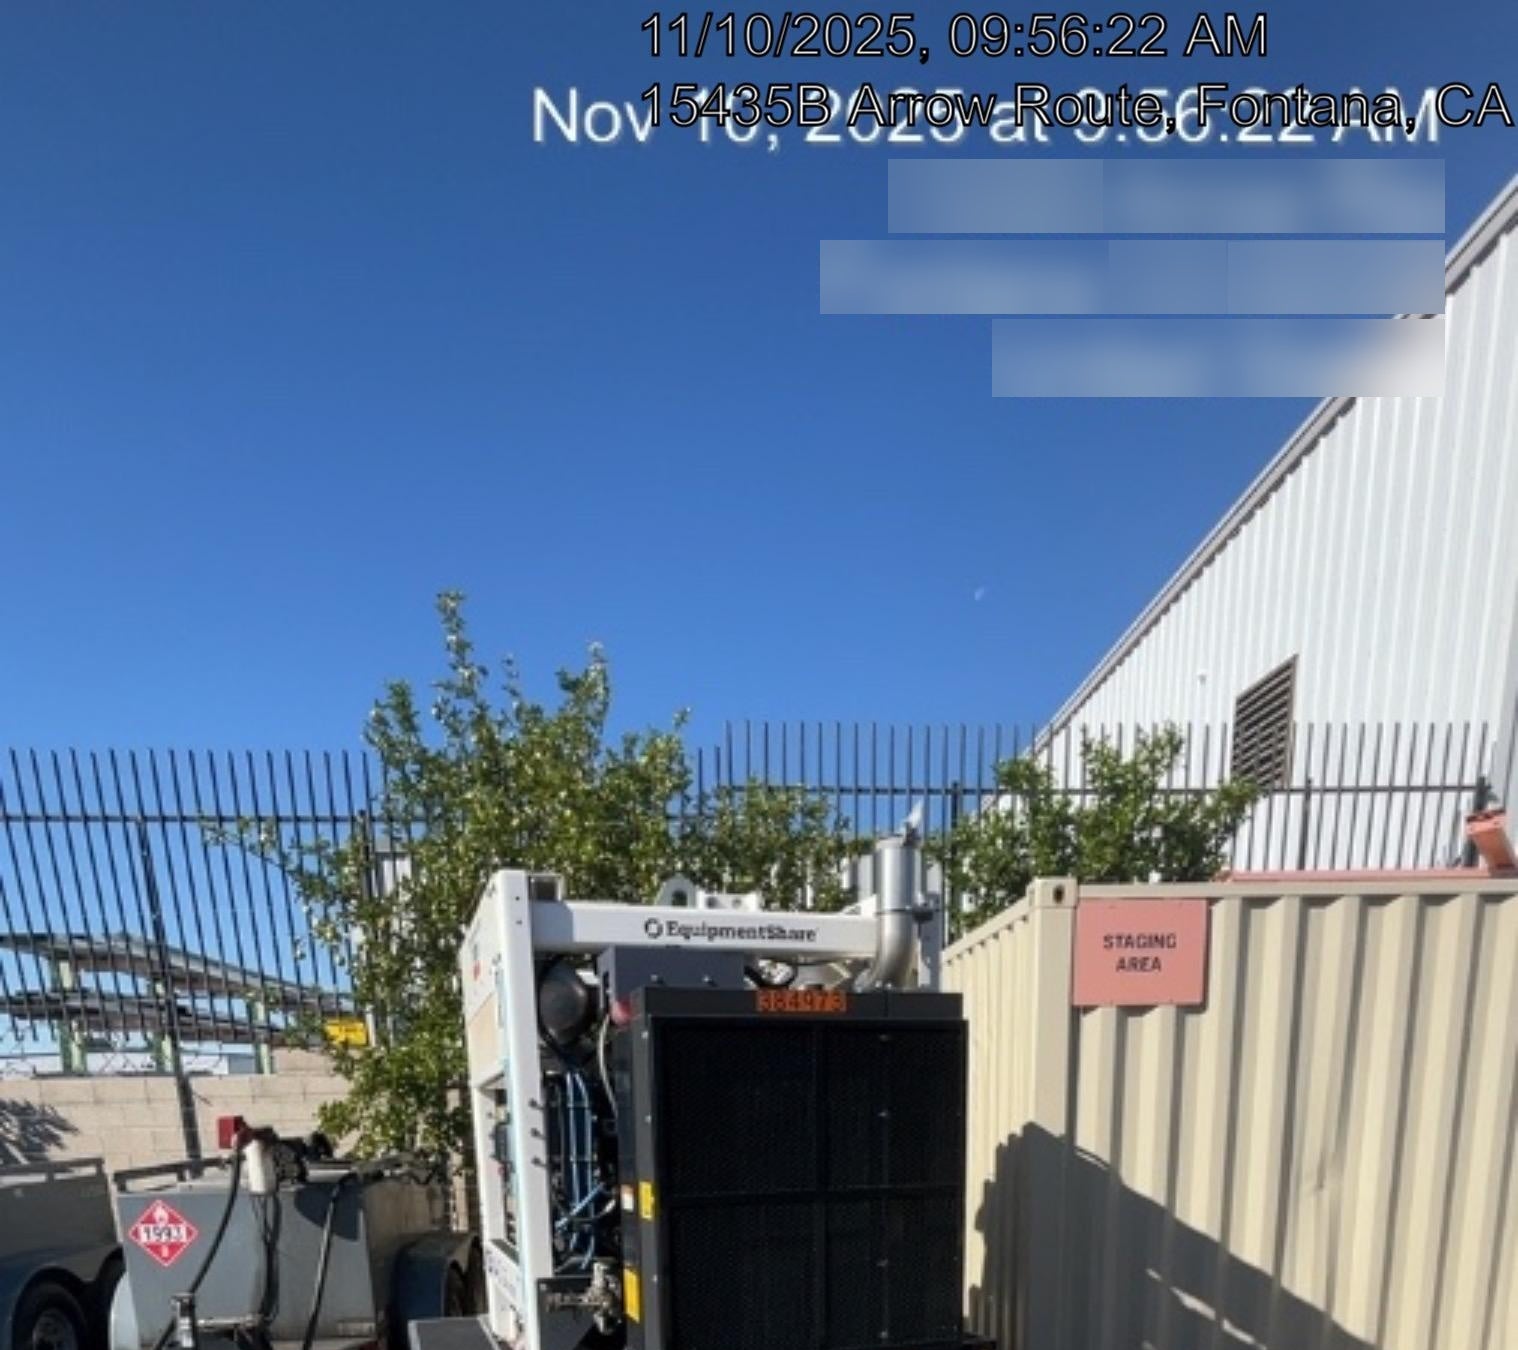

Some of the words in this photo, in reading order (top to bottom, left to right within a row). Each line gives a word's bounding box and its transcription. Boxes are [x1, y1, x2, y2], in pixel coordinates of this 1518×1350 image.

[665, 920, 817, 942] EquipmentShare
[1103, 932, 1177, 949] STAGING
[1115, 956, 1162, 972] AREA
